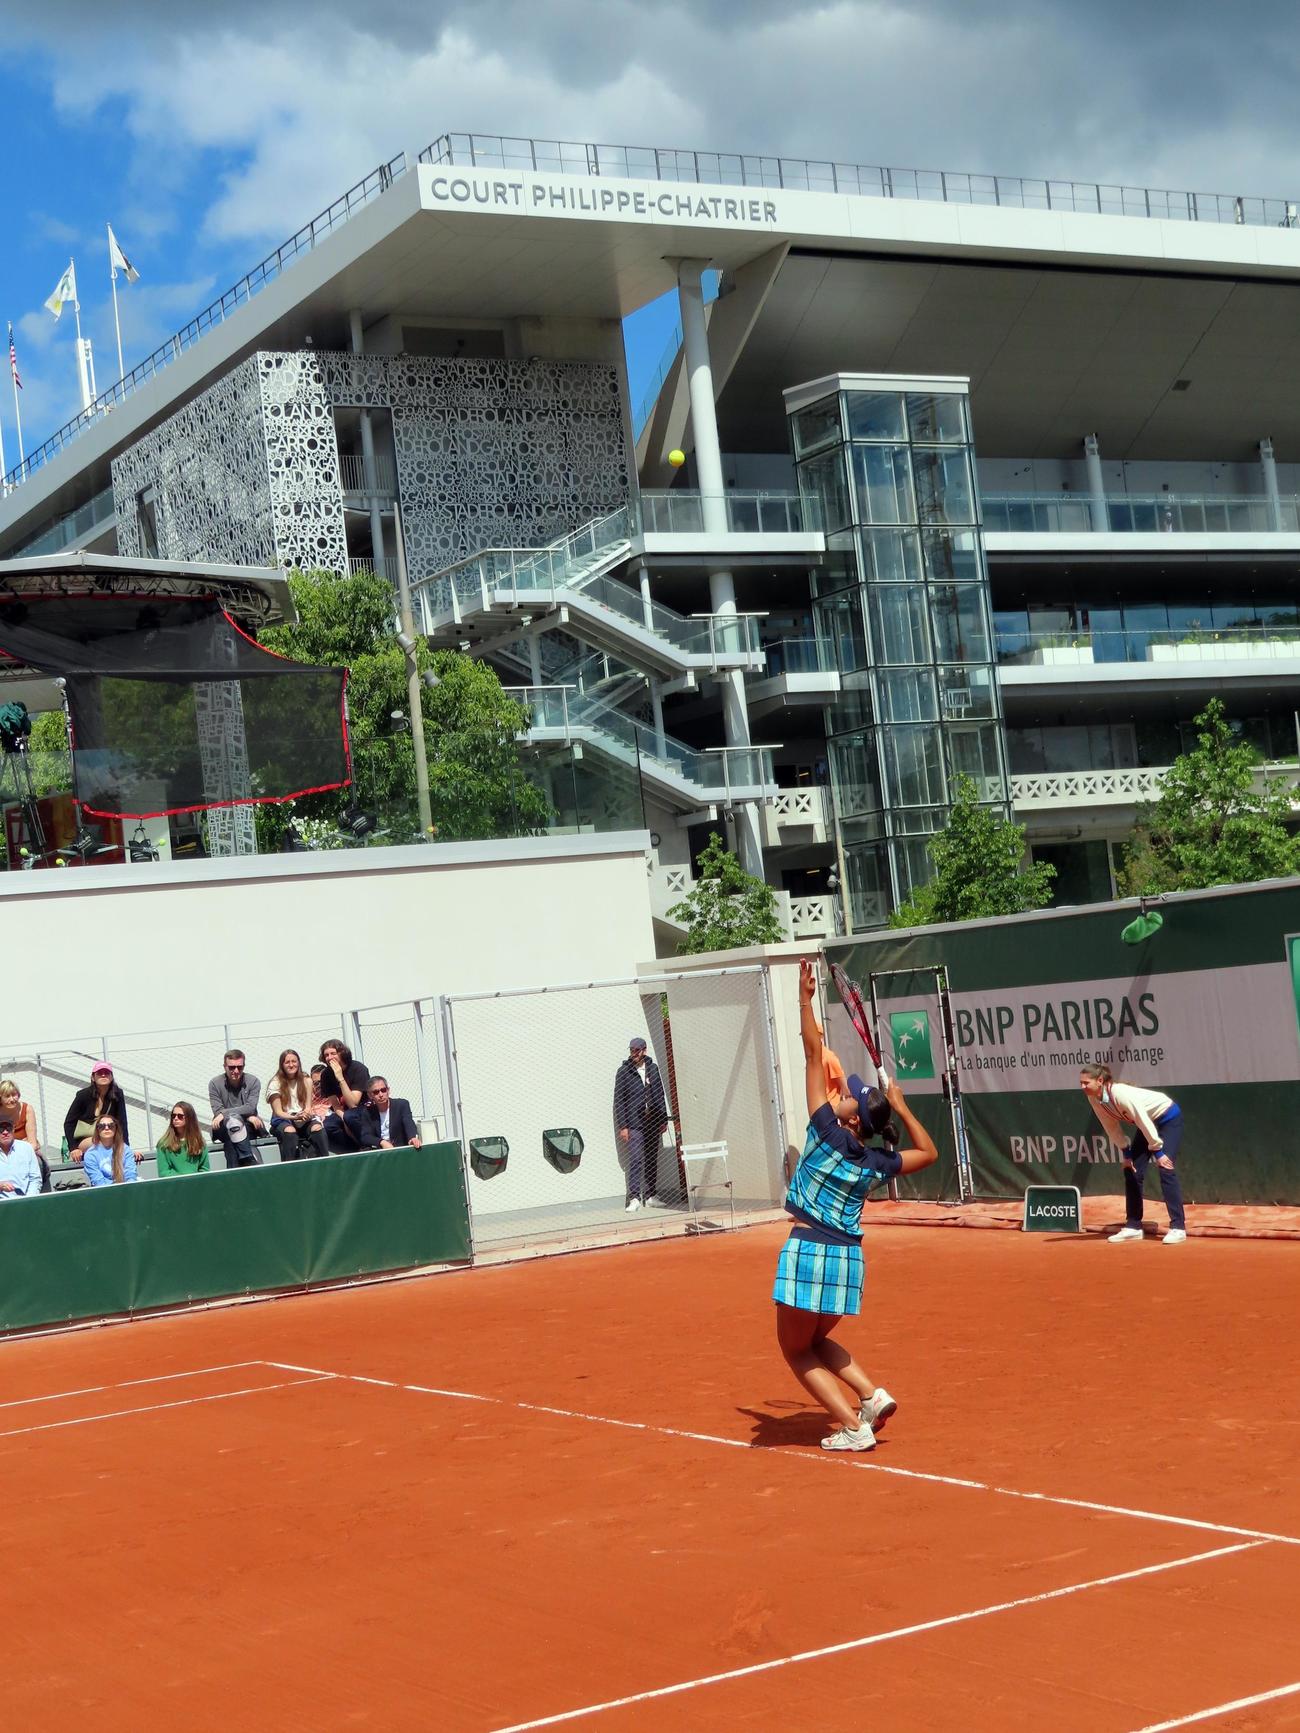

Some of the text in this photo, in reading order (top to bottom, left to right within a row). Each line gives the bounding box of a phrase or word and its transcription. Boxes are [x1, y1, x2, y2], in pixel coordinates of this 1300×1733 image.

[431, 177, 778, 223] COURT PHILIPPE-CHATRIER
[955, 992, 1159, 1047] BNP PARIBAS
[961, 1046, 1164, 1072] La banque d'un monde qui change
[1010, 1135, 1057, 1163] BNP
[1029, 1205, 1076, 1217] LACOSTE
